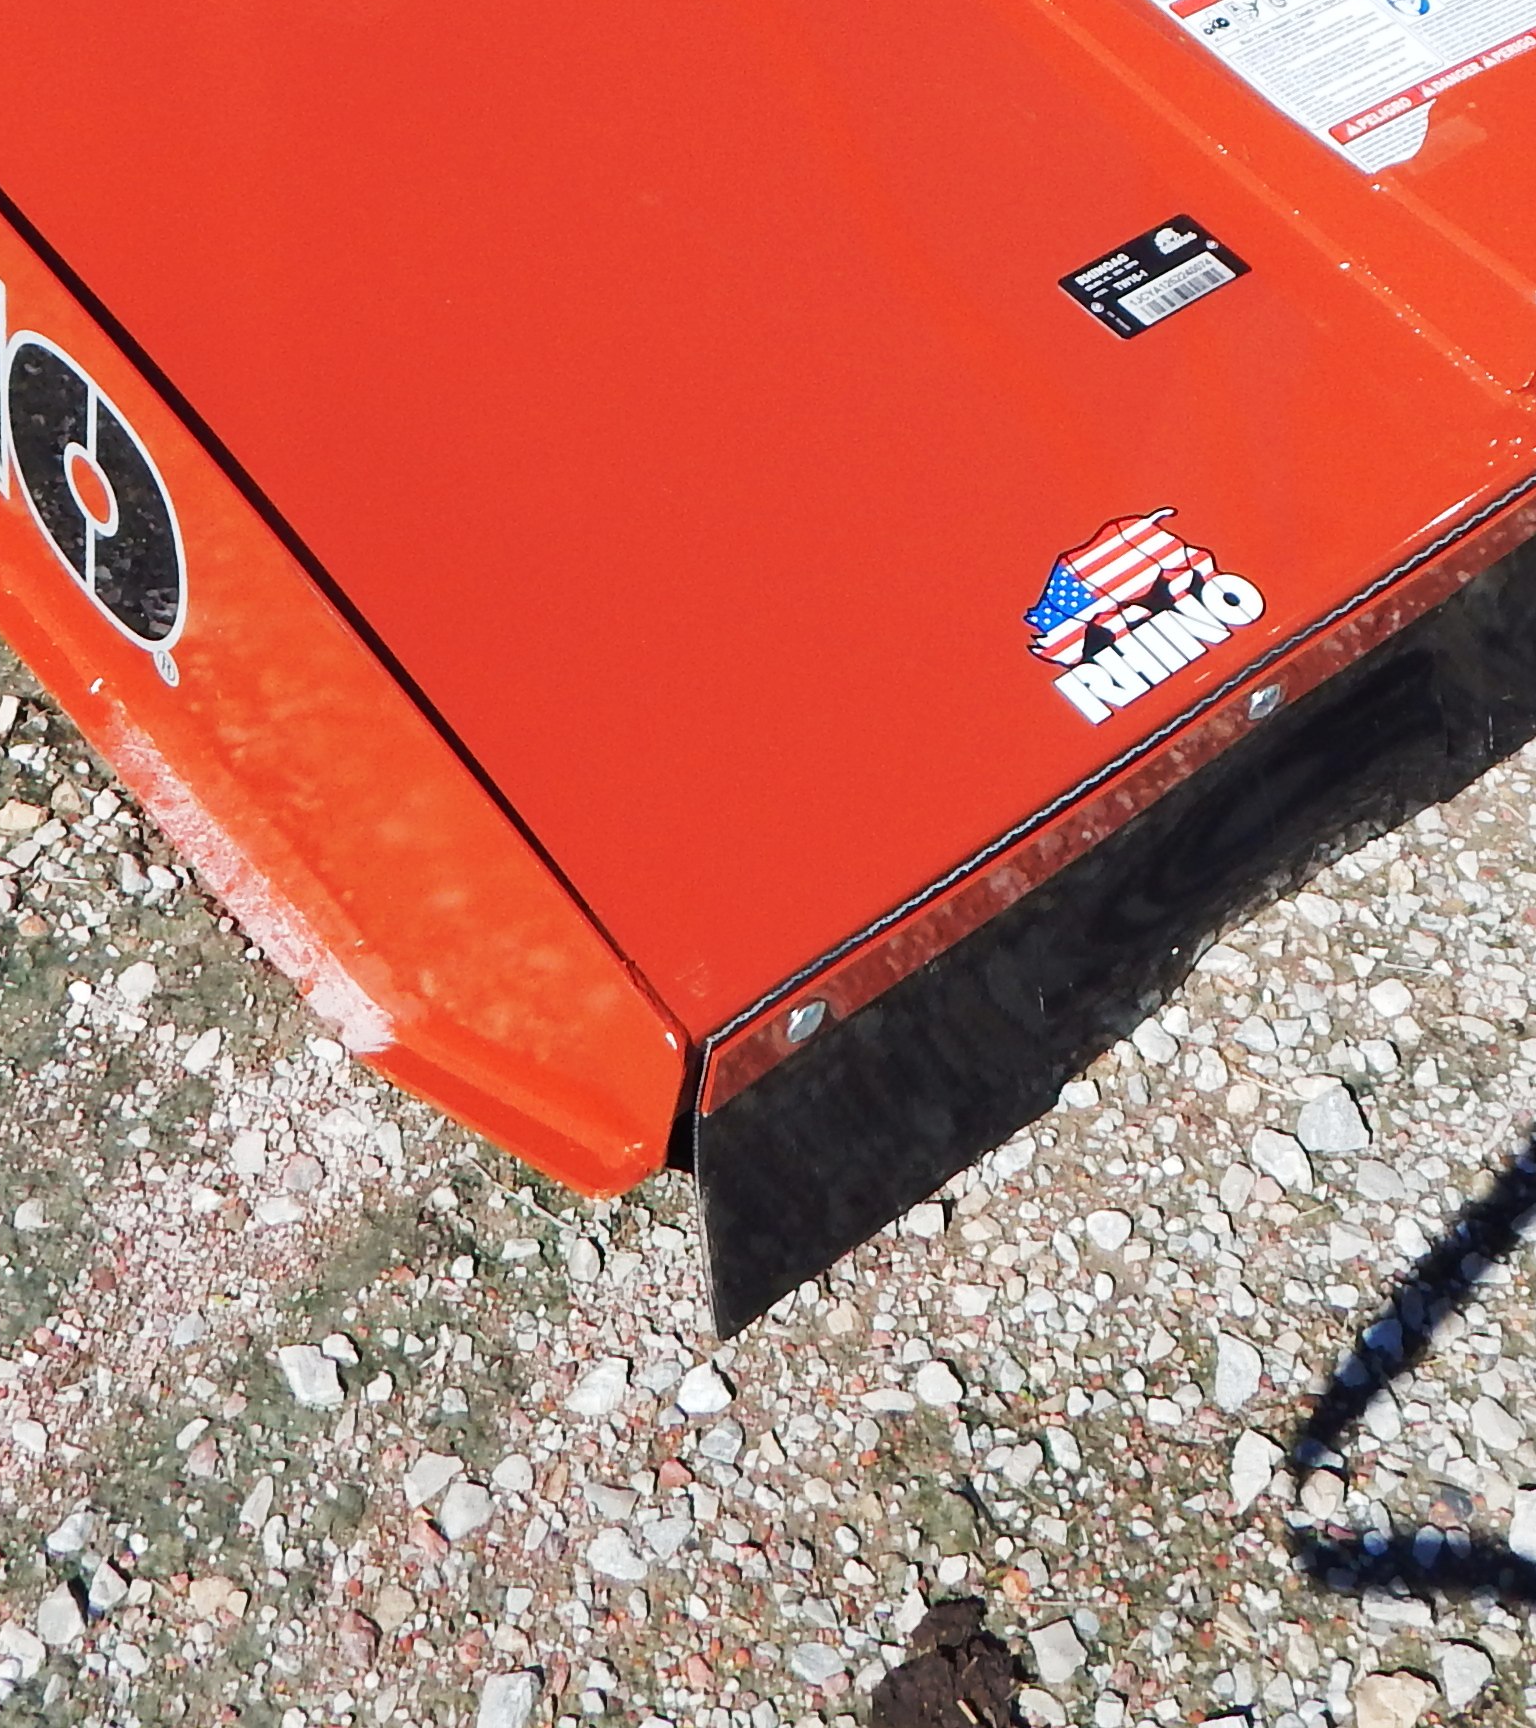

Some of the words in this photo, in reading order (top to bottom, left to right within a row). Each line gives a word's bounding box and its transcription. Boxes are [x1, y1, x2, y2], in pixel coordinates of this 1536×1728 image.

[1492, 35, 1536, 62] PERIGO
[1430, 61, 1483, 92] DANGER
[1358, 96, 1412, 131] PELIGRO
[1053, 573, 1265, 726] RHINO
